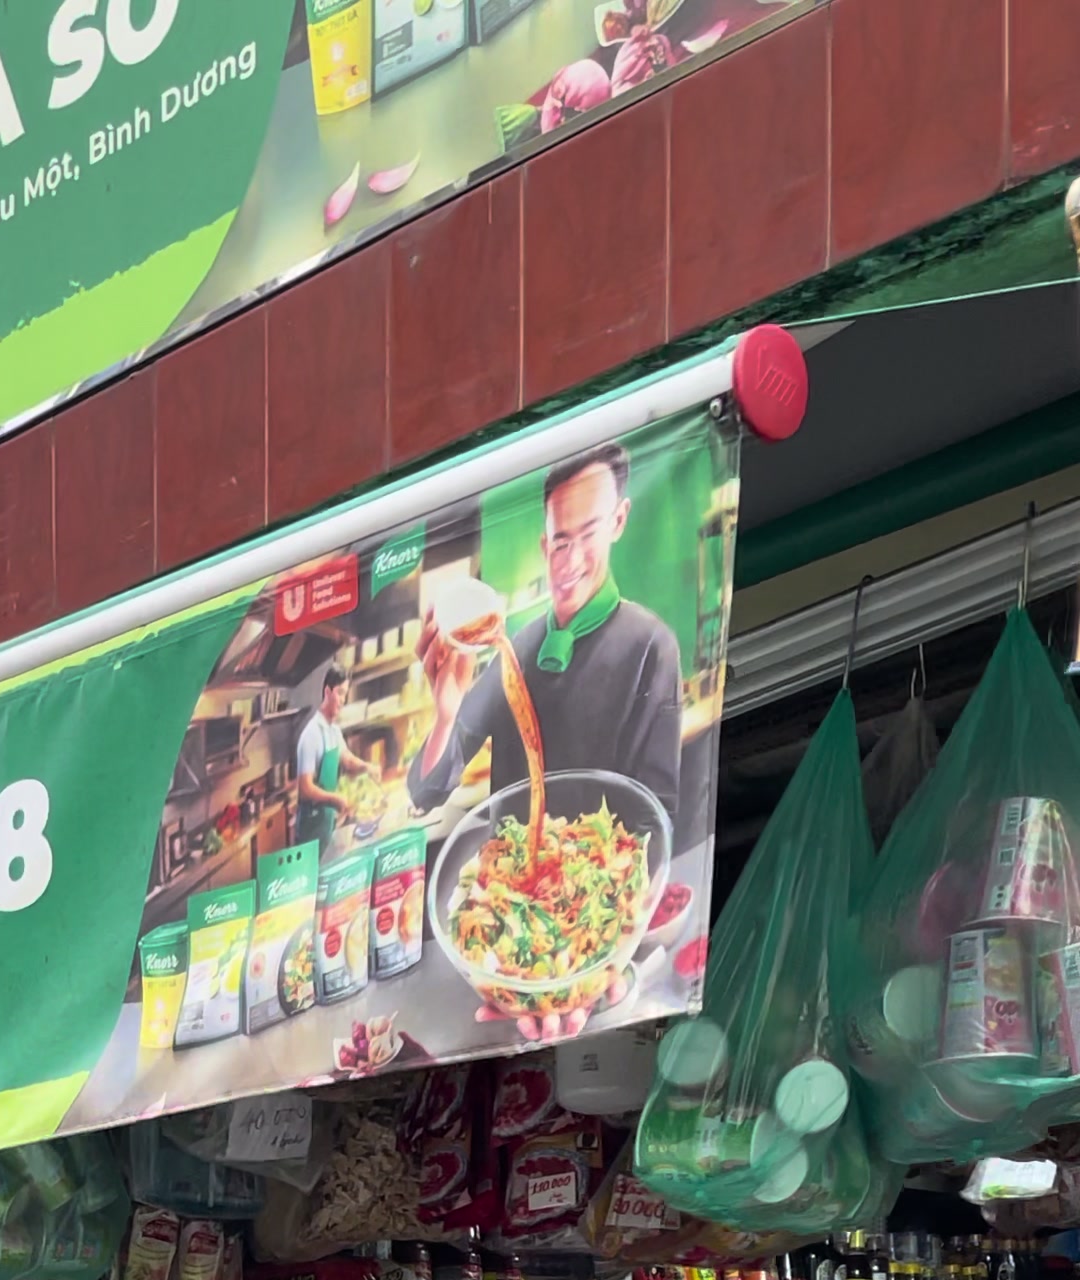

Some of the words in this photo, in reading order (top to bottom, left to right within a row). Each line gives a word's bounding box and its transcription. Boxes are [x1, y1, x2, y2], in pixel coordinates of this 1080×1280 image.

[24, 158, 81, 211] Một,
[89, 107, 150, 163] Bình
[159, 40, 257, 124] Dương
[375, 546, 419, 575] Knorr
[204, 902, 238, 921] Knorr
[146, 952, 179, 970] Knorr
